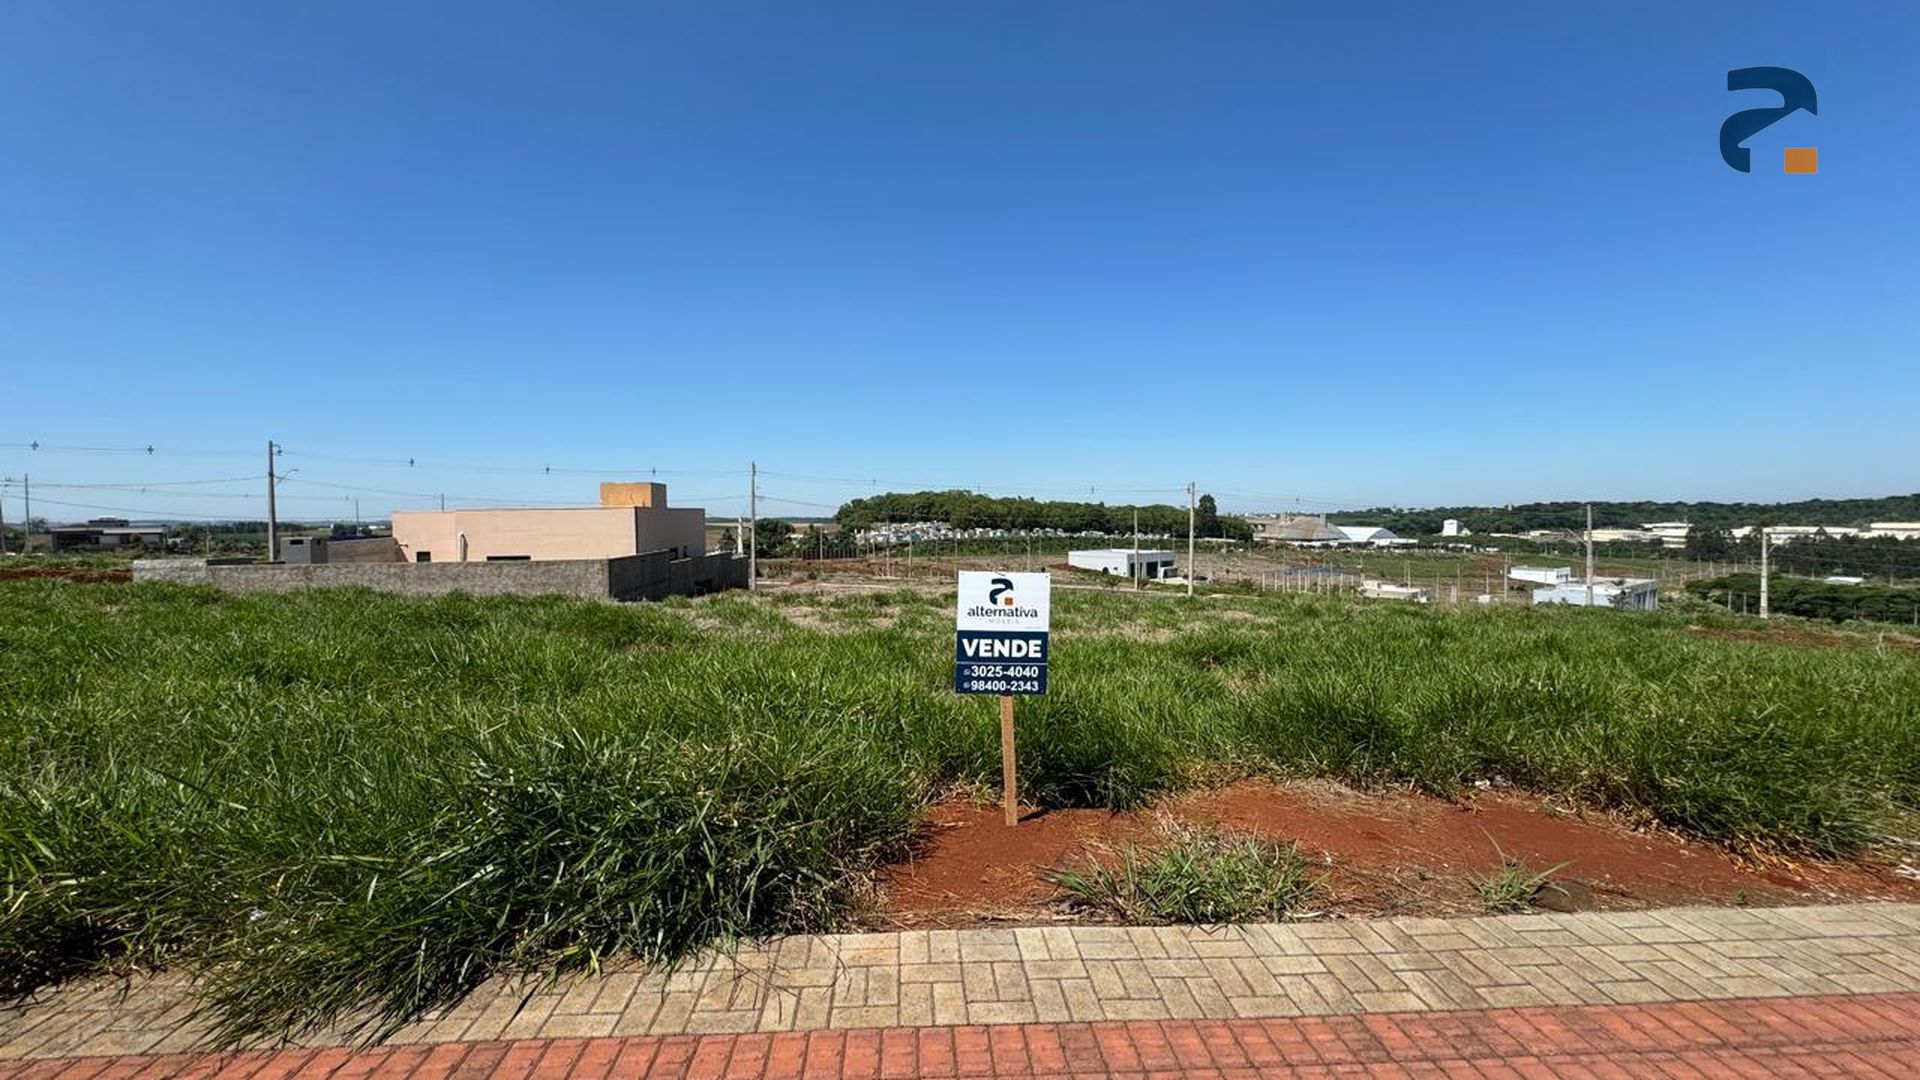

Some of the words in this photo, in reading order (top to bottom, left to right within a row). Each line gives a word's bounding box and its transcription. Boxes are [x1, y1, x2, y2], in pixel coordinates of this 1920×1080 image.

[967, 606, 1038, 618] alternativa
[962, 638, 1042, 658] VENDE
[971, 665, 1039, 677] 3025-4040
[970, 680, 1039, 692] 98400-2343
